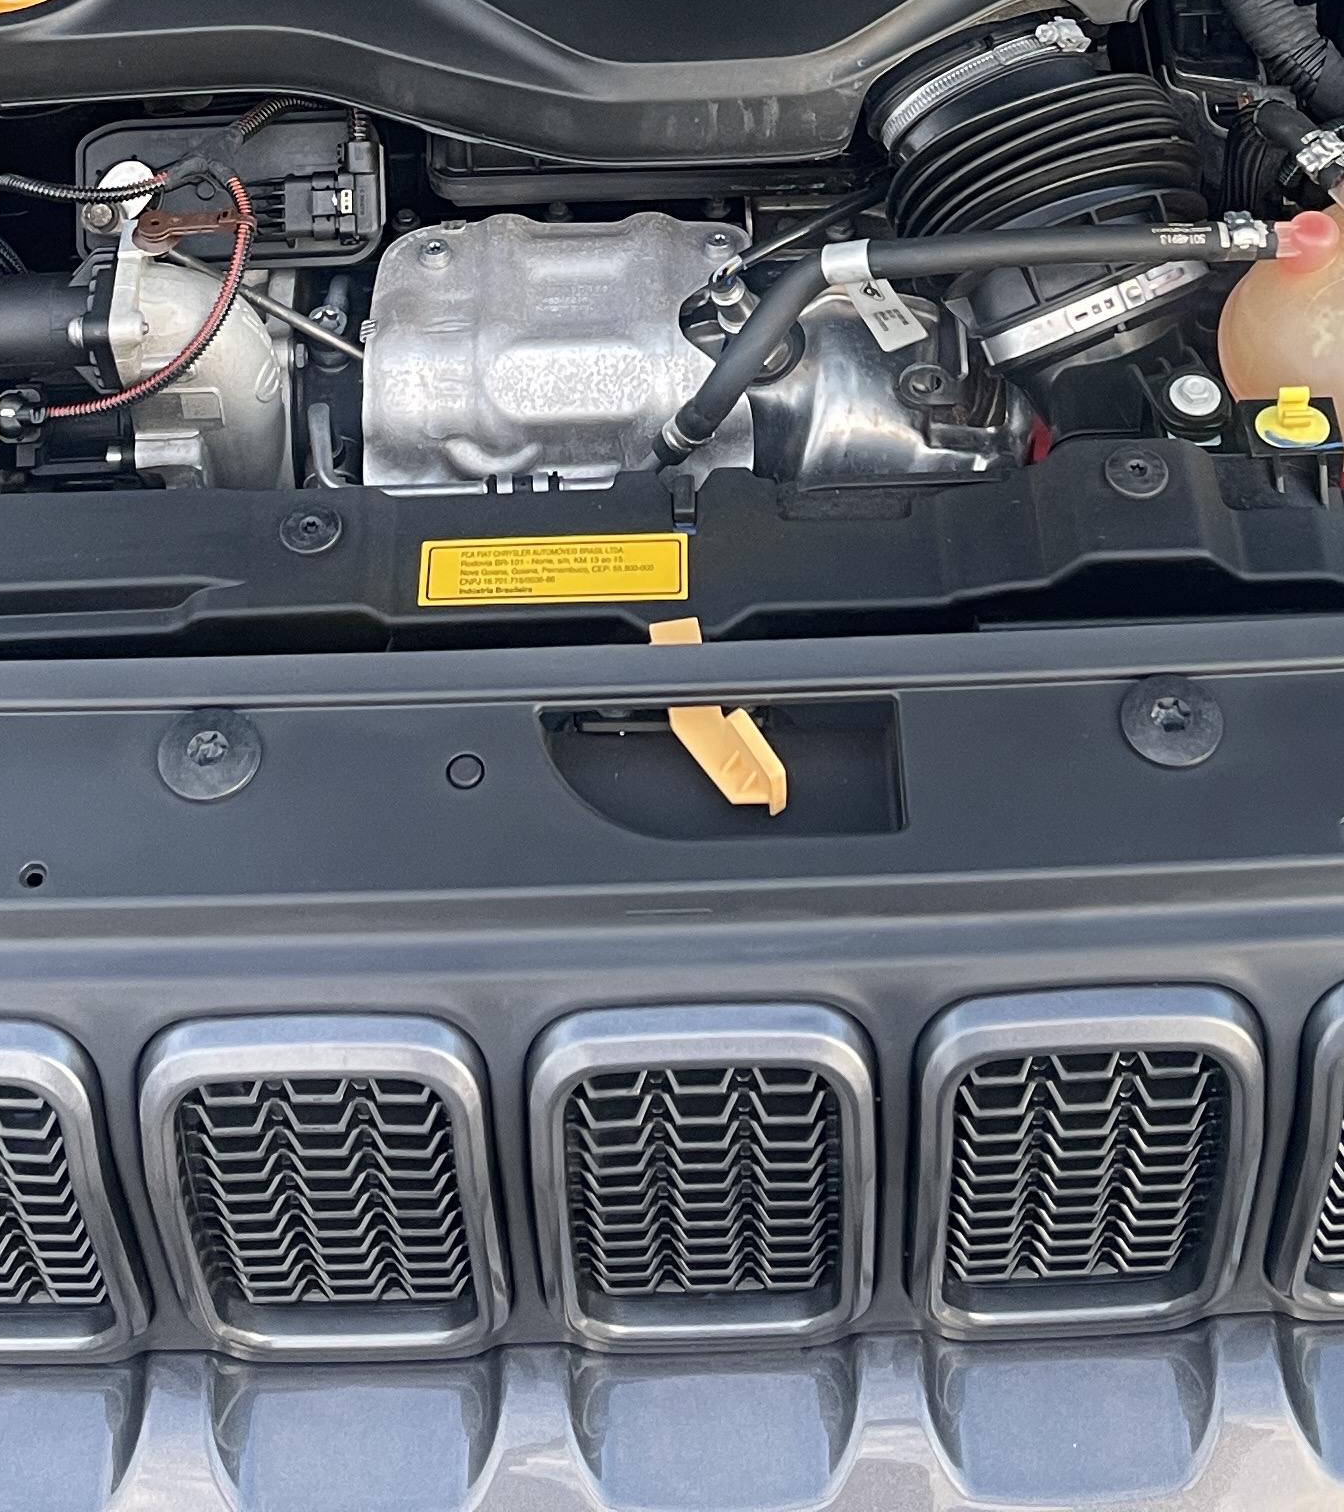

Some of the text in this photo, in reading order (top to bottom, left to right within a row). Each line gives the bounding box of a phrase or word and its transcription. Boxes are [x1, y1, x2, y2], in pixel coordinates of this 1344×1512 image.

[476, 550, 492, 558] FIAT
[493, 549, 530, 558] CHRYSLER
[579, 547, 603, 555] BRASIL
[461, 559, 493, 567] Rodovia
[460, 577, 482, 585] CNPJ
